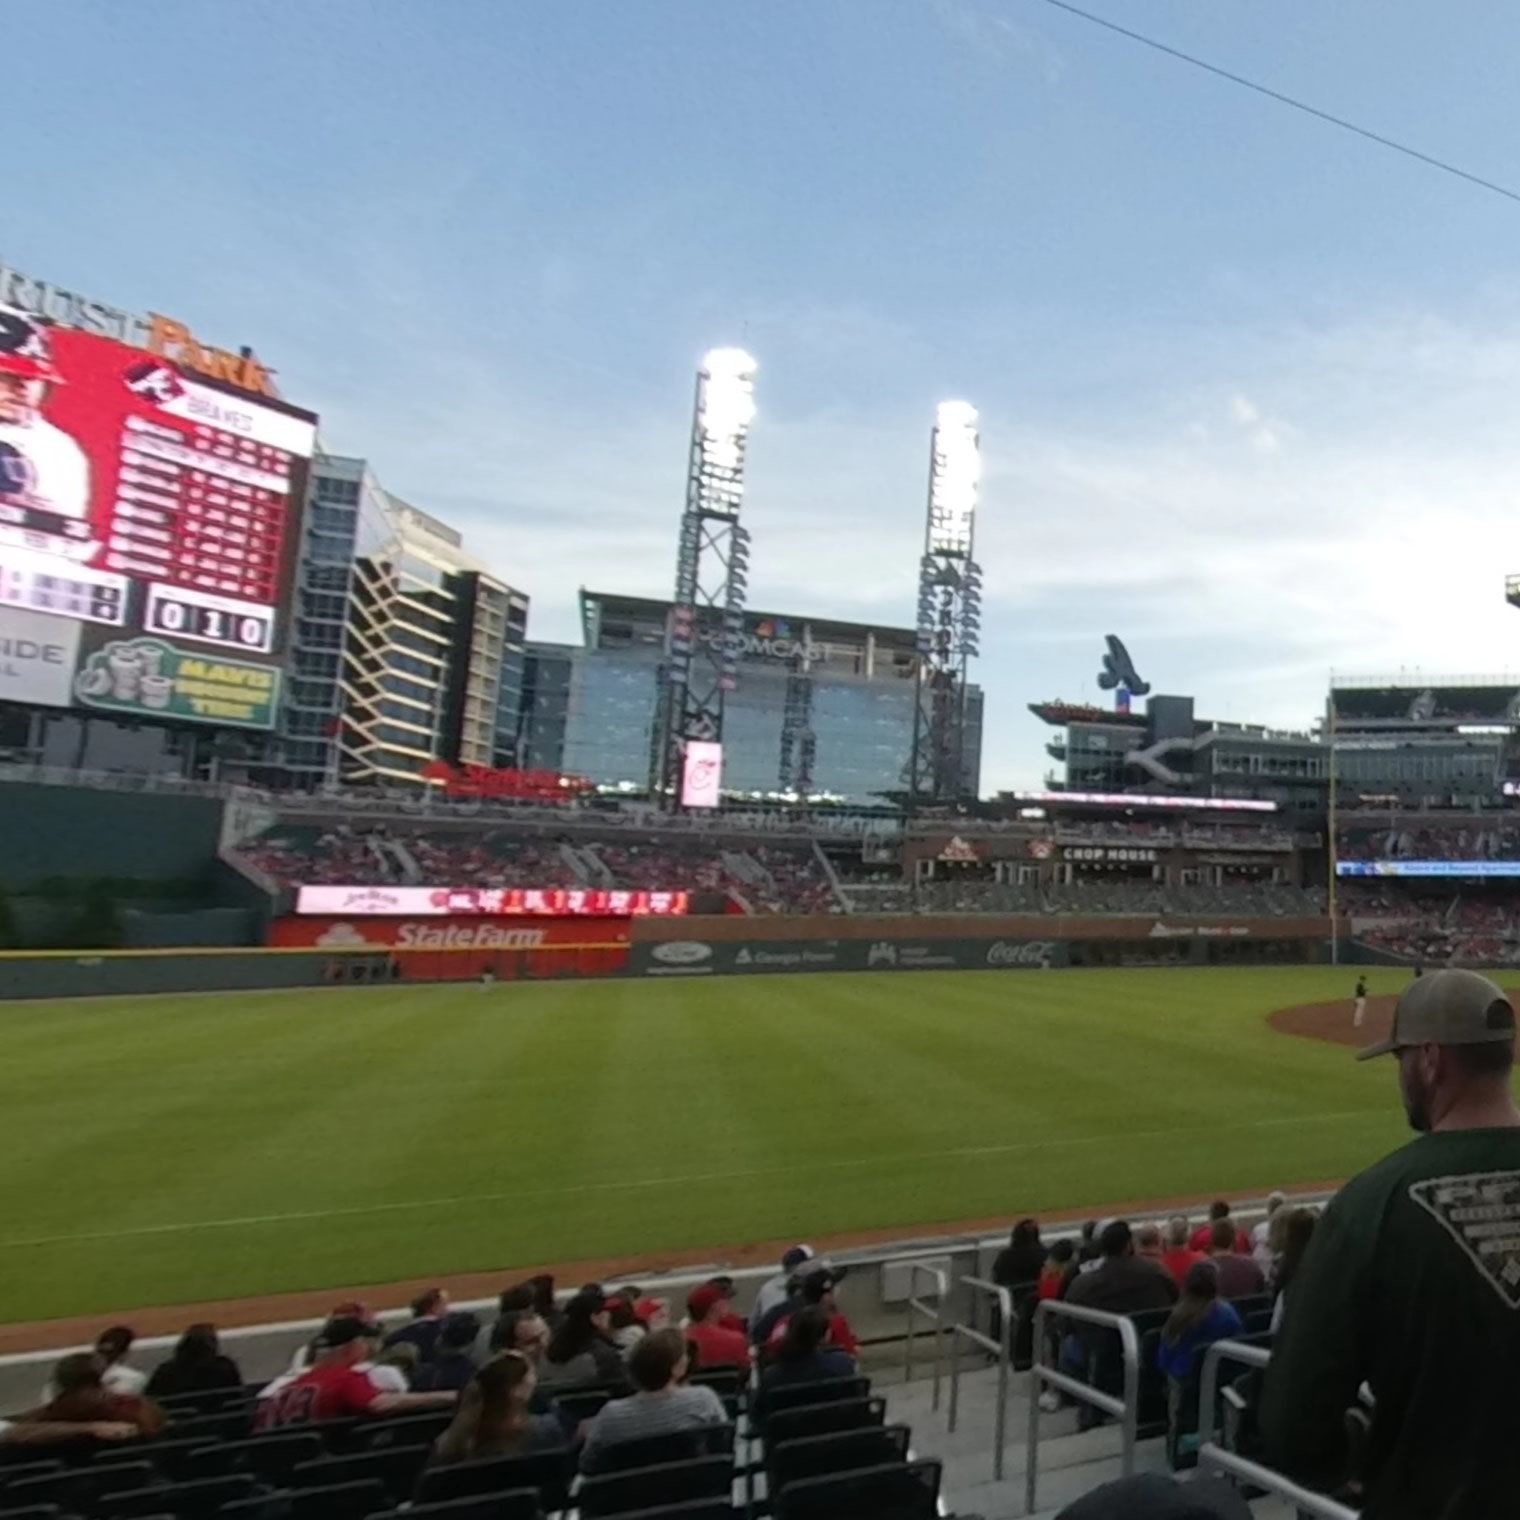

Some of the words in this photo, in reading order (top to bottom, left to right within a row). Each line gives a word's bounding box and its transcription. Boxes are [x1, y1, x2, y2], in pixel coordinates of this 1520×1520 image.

[147, 312, 279, 398] Park
[187, 396, 254, 431] BRAVES
[161, 602, 184, 629] 0
[206, 612, 222, 637] 1
[240, 619, 260, 643] 0
[709, 630, 832, 662] COMCAST
[1063, 847, 1104, 861] CHOP
[1107, 847, 1157, 862] HOUSE
